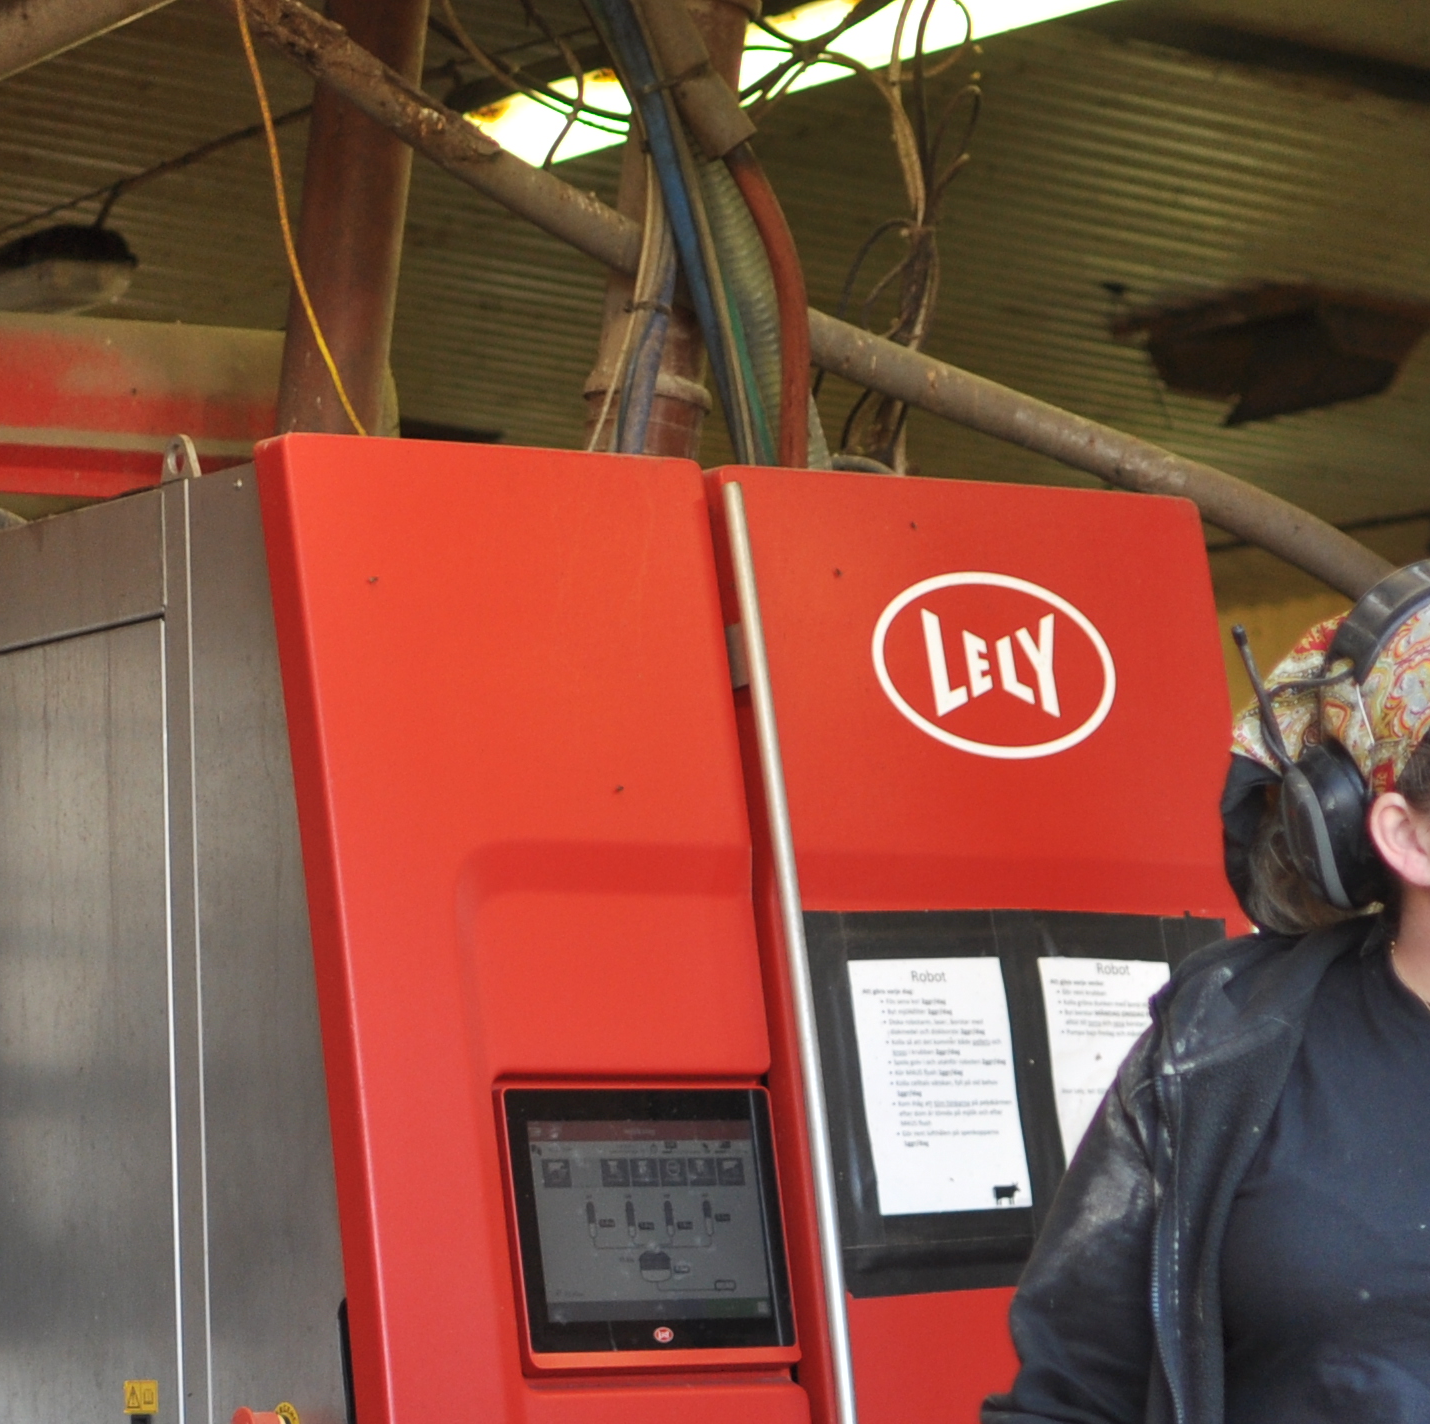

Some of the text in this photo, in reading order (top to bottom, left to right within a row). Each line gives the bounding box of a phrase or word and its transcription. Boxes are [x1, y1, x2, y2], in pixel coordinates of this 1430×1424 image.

[920, 607, 1061, 718] LELY
[1096, 963, 1131, 976] Robot
[911, 970, 947, 983] Robot
